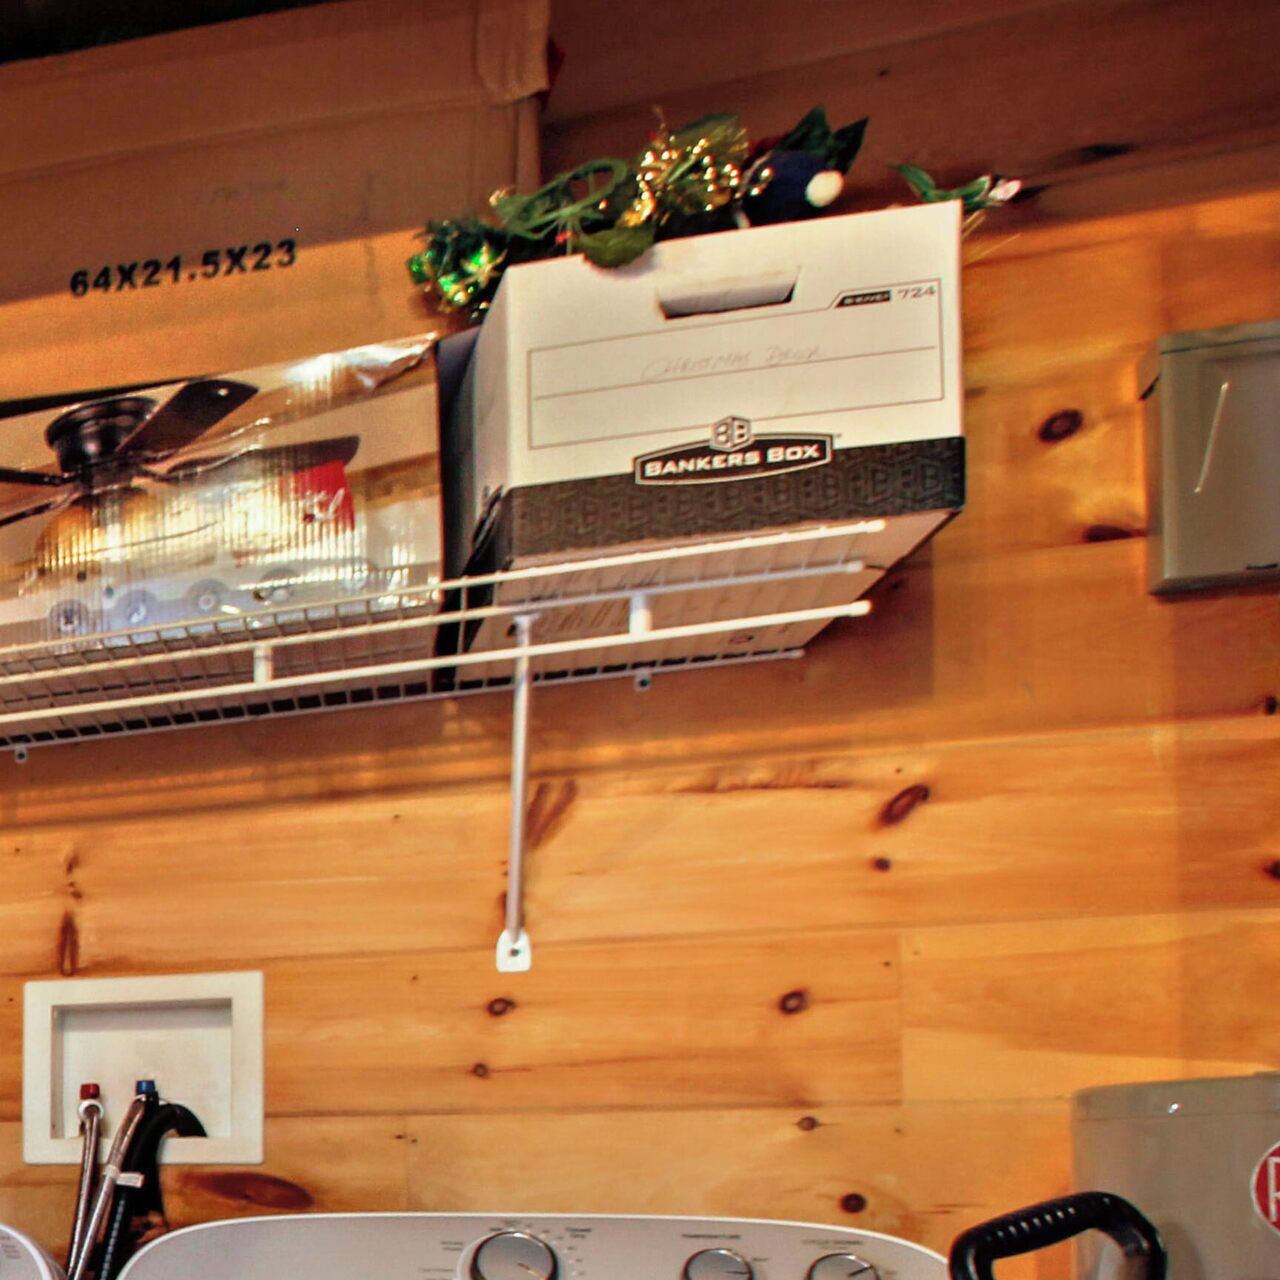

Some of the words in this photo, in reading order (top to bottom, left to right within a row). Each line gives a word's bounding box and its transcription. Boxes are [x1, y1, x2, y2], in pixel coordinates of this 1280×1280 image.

[70, 238, 297, 297] 64X21.5X23
[644, 450, 761, 477] BANKERS
[766, 443, 820, 463] BOX
